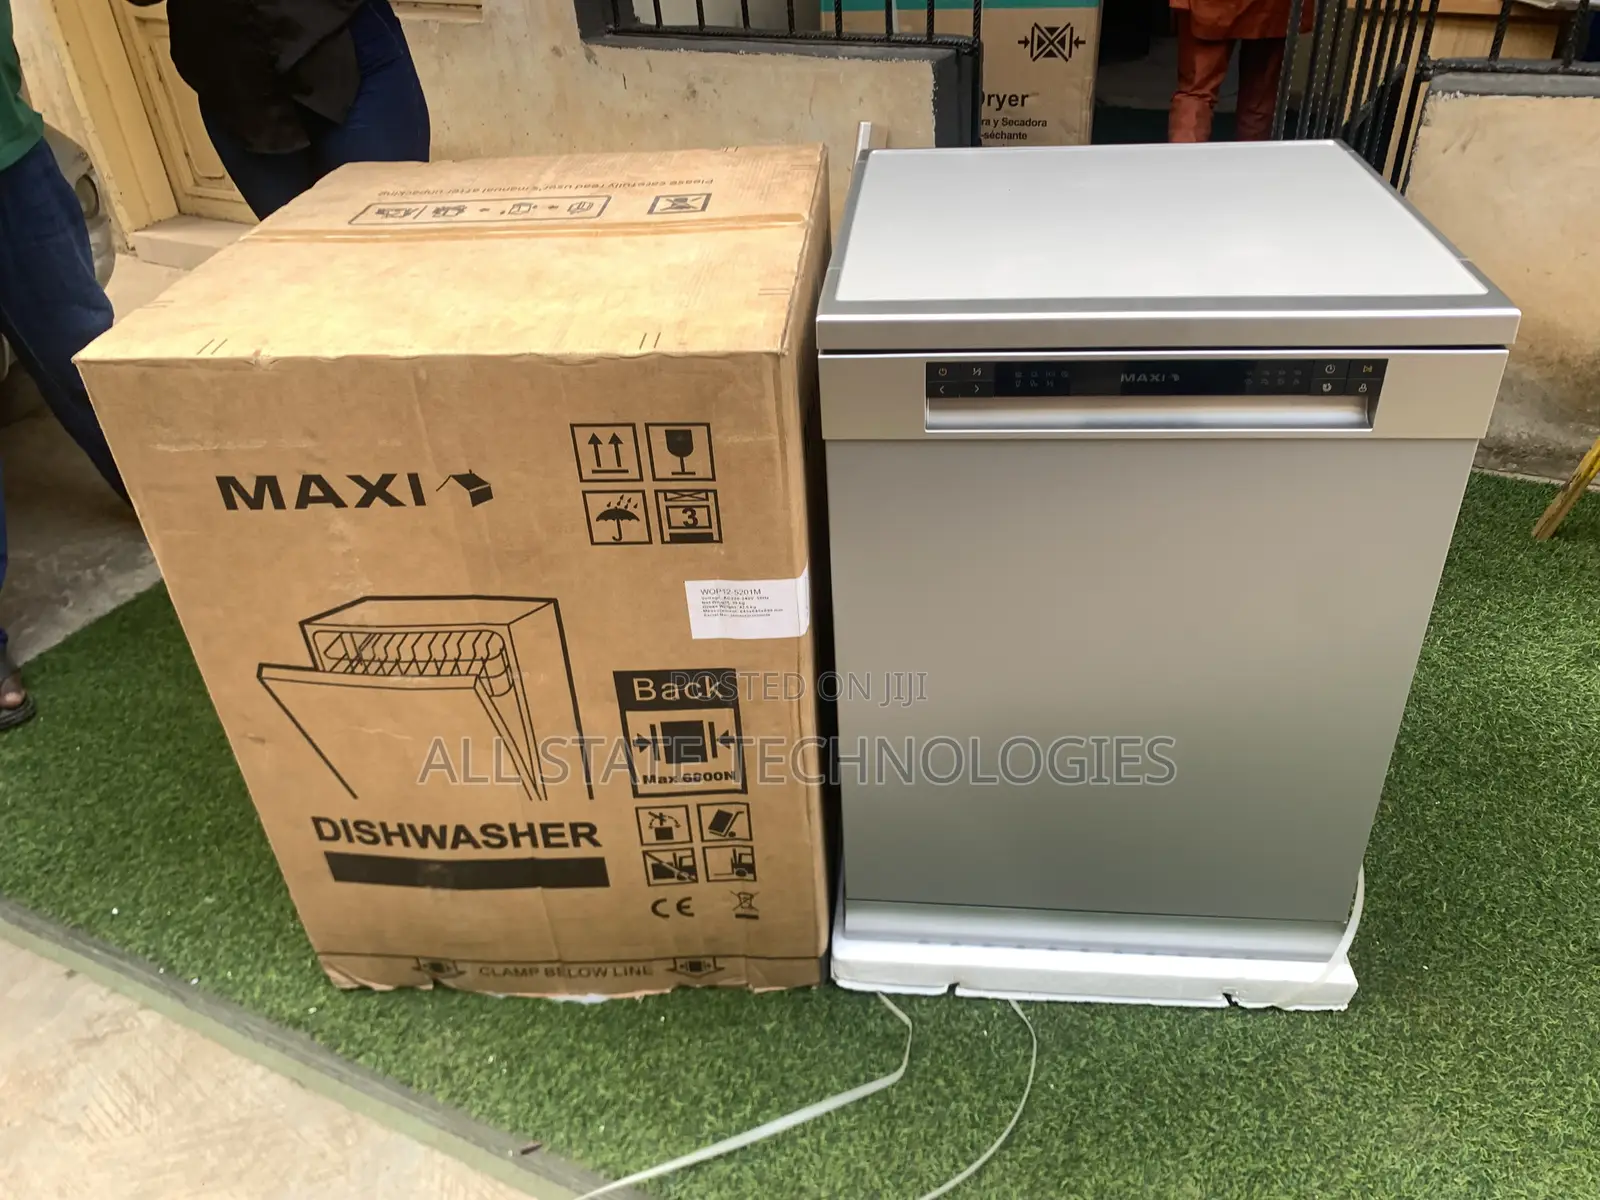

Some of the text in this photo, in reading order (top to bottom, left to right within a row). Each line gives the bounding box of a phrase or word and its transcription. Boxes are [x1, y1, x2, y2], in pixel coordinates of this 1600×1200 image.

[981, 91, 1029, 111] ryer
[1001, 117, 1048, 127] Secadora
[981, 130, 1028, 140] -séchante
[670, 179, 714, 187] Please
[1120, 373, 1166, 383] MAXI
[215, 472, 427, 511] MAXI
[682, 507, 699, 528] 3
[632, 675, 724, 702] Back
[642, 774, 678, 785] Max
[311, 816, 602, 850] DISHWASHER
[479, 965, 654, 979] CLAMP BELOW LINE
